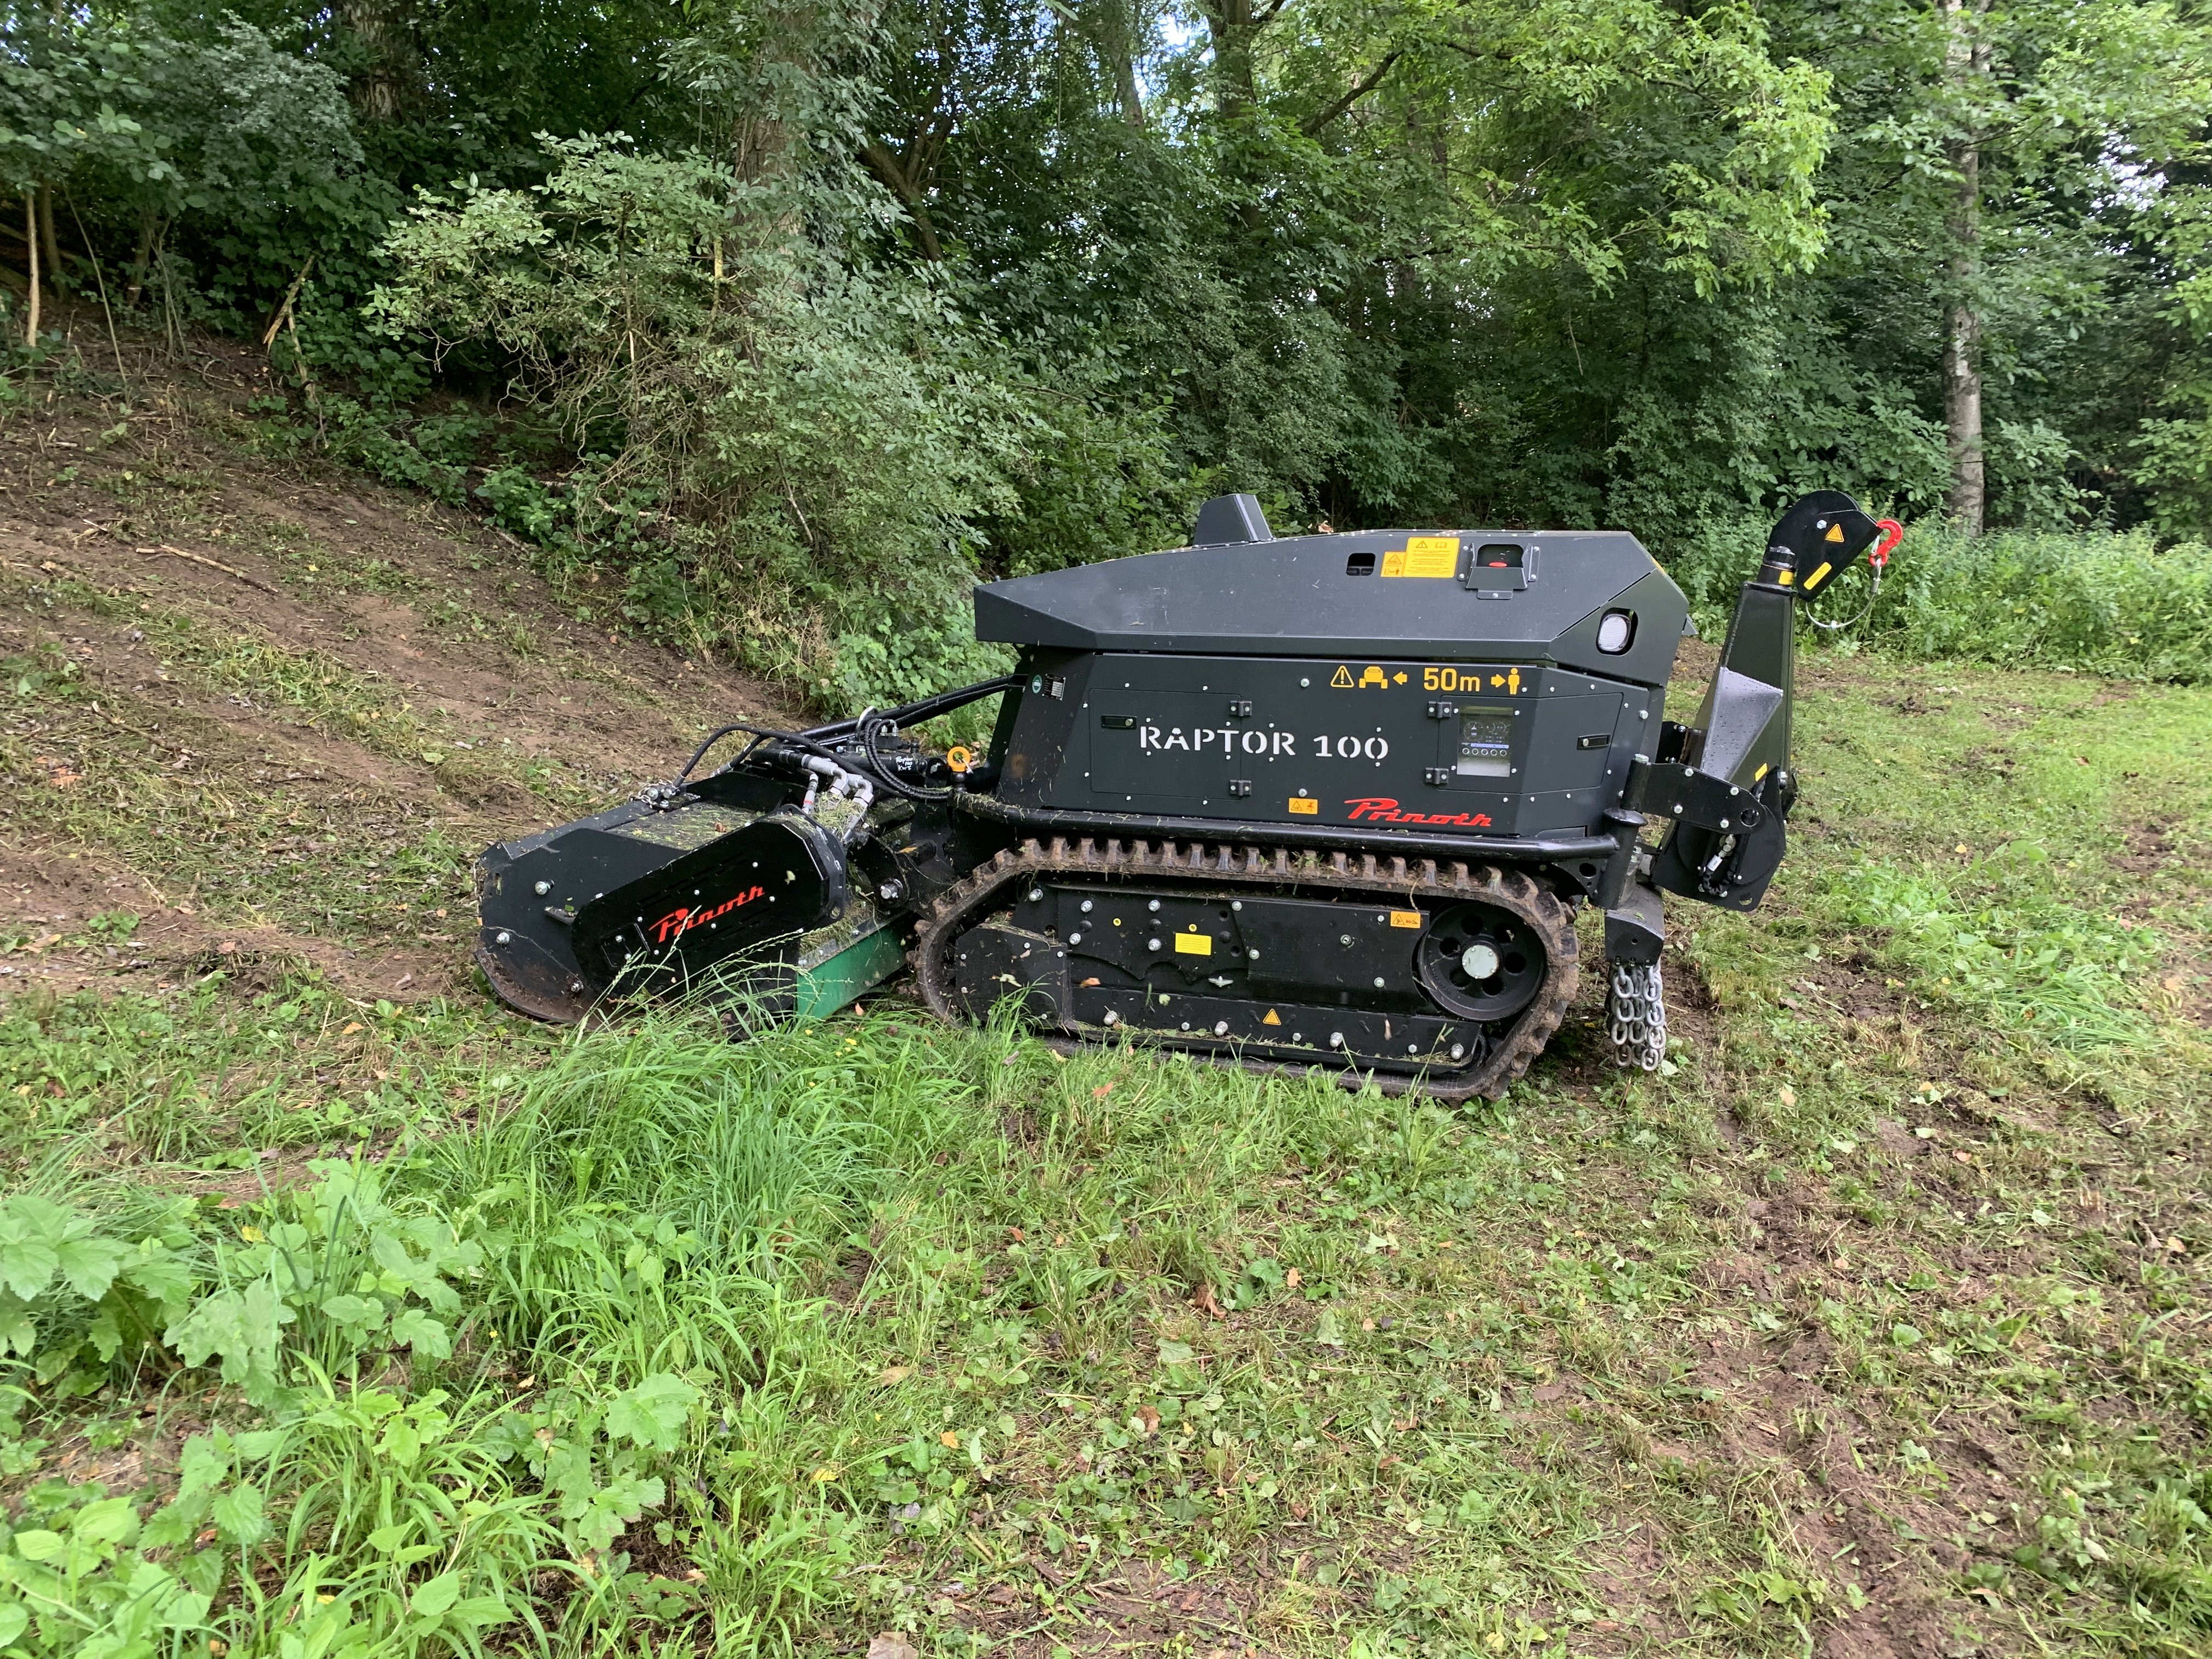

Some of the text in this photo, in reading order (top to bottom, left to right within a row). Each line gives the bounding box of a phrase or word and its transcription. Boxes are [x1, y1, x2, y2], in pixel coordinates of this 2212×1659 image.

[1424, 668, 1480, 691] 50m
[1141, 726, 1388, 759] RAPTOR 100
[1344, 797, 1492, 827] Prinoth
